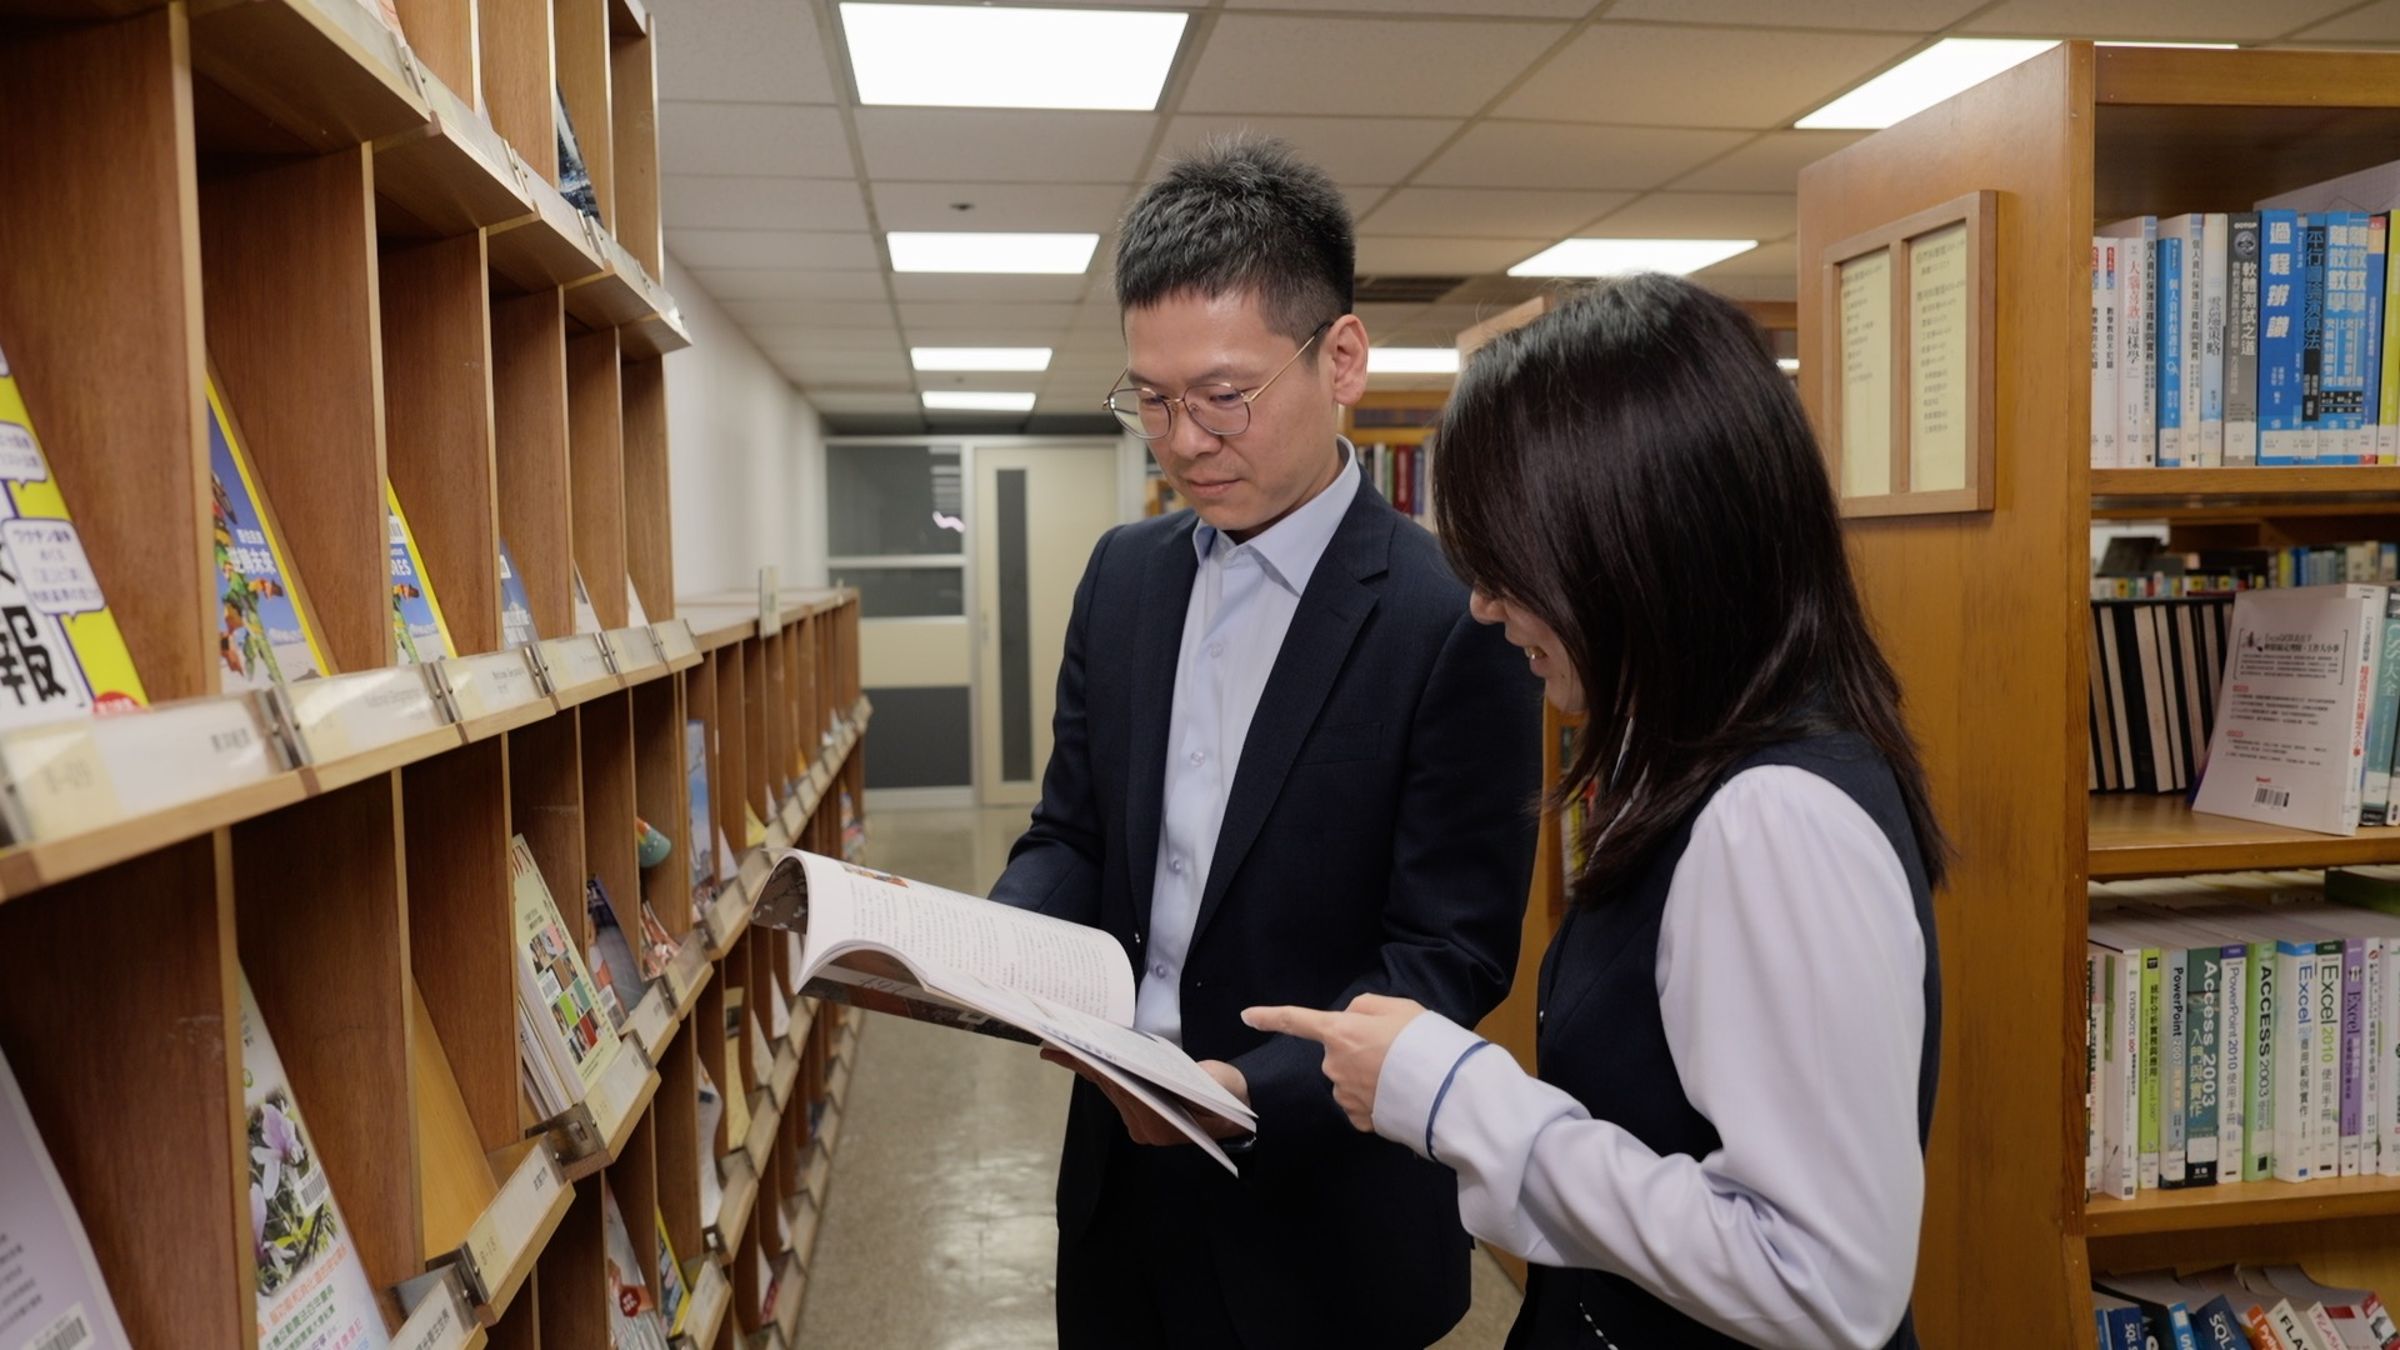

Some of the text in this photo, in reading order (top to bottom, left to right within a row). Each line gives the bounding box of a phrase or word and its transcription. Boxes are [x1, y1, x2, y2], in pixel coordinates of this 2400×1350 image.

[2241, 261, 2257, 356] 軟體測試之道
[2173, 967, 2184, 1037] PowerPoint
[2228, 967, 2240, 1037] PowerPoint
[2259, 965, 2272, 1058] ACCESS
[2298, 965, 2313, 1026] Excel
[2320, 965, 2340, 1025] Excel
[2346, 991, 2361, 1035] Excel
[2202, 960, 2218, 1108] Access 2003
[2228, 1039, 2239, 1070] 2010
[2320, 1026, 2334, 1063] 2010
[2258, 1059, 2270, 1099] 2003
[2124, 1323, 2135, 1345] SQL
[2208, 1313, 2231, 1350] SQL
[2279, 1314, 2309, 1350] FLA
